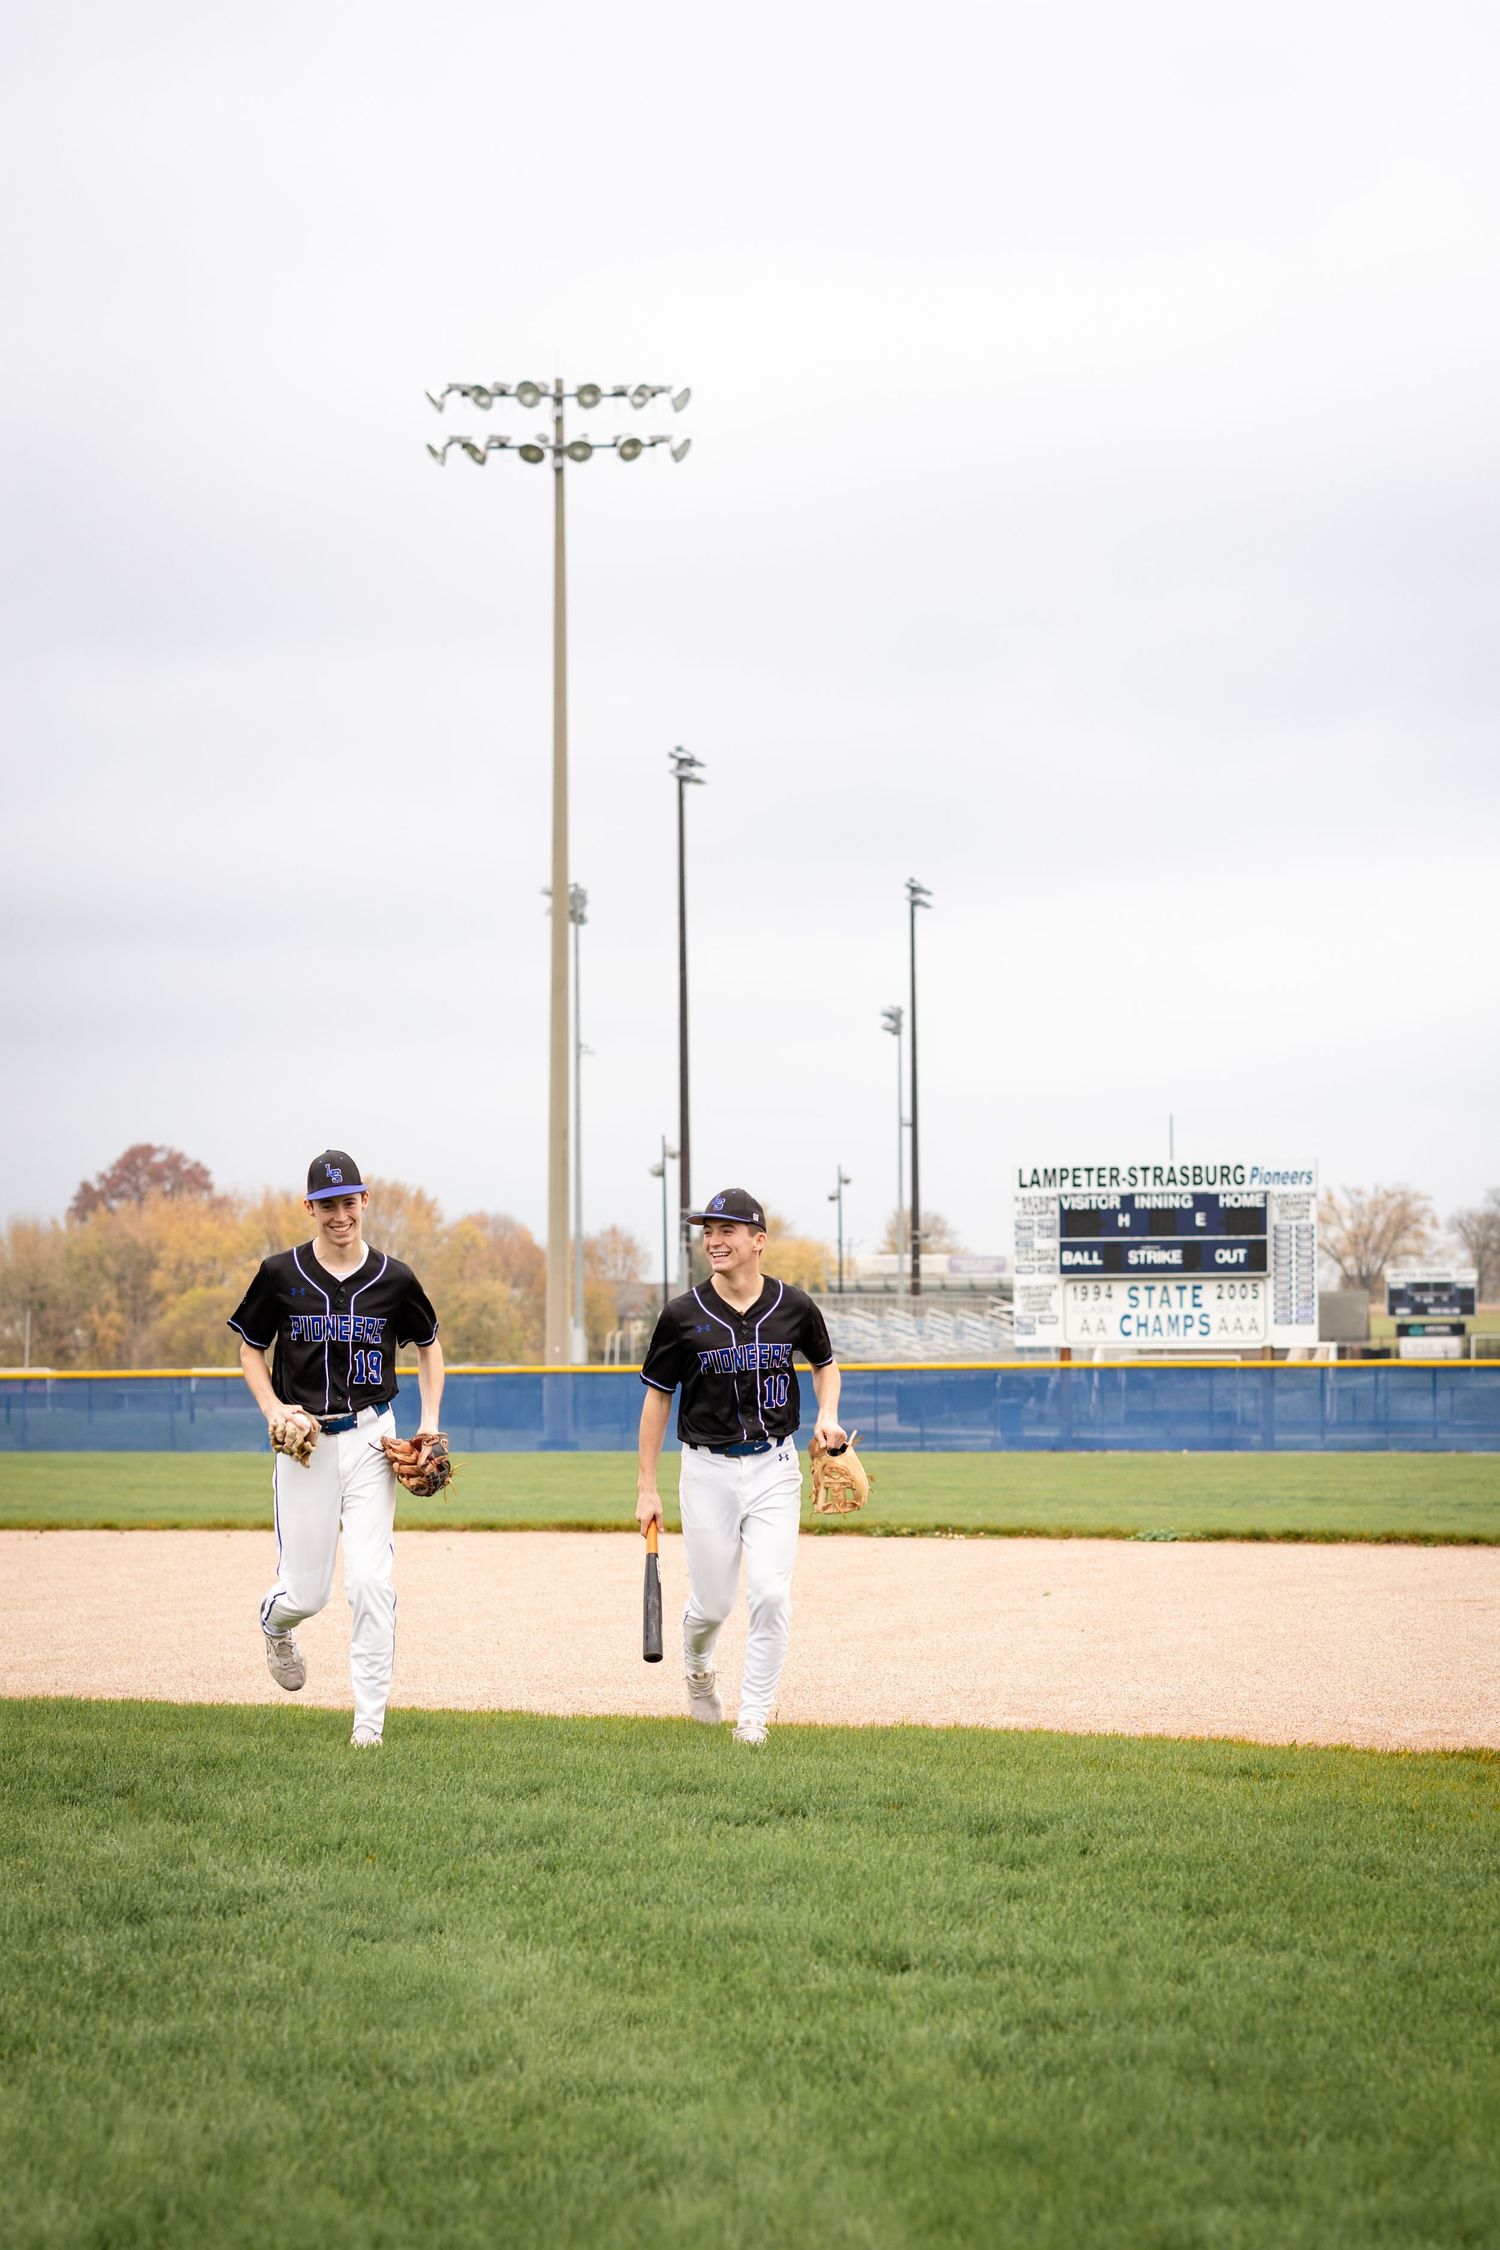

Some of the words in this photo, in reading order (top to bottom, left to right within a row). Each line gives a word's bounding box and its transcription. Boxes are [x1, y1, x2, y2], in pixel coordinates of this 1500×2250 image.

[1018, 1165, 1245, 1188] LAMPETER-STRASBURG
[1249, 1166, 1313, 1186] Pioneers
[1061, 1195, 1121, 1209] VISITOR
[1134, 1194, 1194, 1209] INNING
[1218, 1193, 1266, 1208] HOME
[1117, 1213, 1131, 1228] H
[1195, 1212, 1208, 1227] E
[1061, 1251, 1103, 1265] BALL
[1127, 1249, 1184, 1264] STRIKE
[1215, 1248, 1248, 1263] OUT
[1073, 1285, 1113, 1301] 1994
[1127, 1285, 1203, 1308] STATE
[1216, 1284, 1259, 1299] 2005
[289, 1315, 387, 1344] PIONEERS
[1119, 1314, 1211, 1337] CHAMPS
[353, 1350, 383, 1385] 19
[698, 1343, 792, 1374] PIONEERS
[763, 1373, 790, 1409] 10
